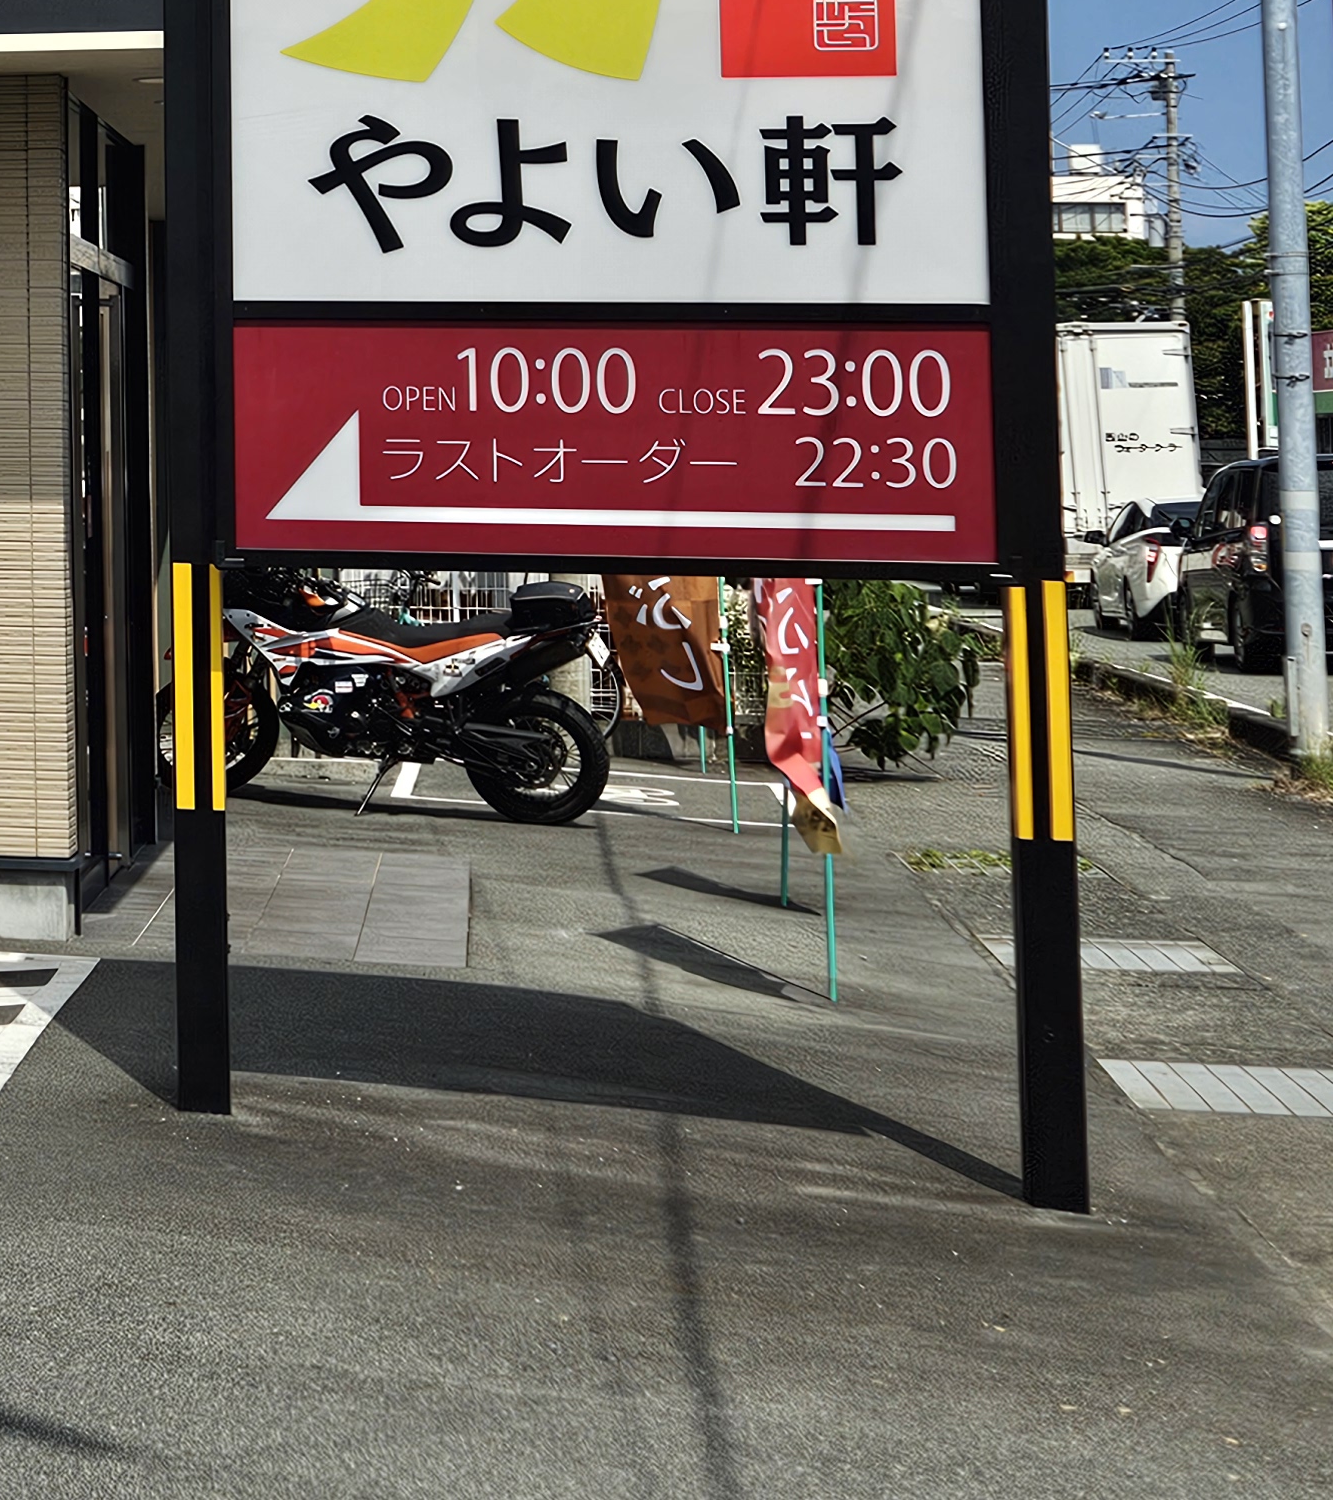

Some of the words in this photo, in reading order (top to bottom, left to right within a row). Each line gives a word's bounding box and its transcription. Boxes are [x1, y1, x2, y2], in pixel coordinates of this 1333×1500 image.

[308, 115, 902, 253] やよい軒
[382, 385, 456, 412] OPEN
[457, 347, 636, 413] 10:00
[658, 388, 746, 415] CLOSE
[757, 348, 951, 417] 23:00
[382, 437, 737, 483] ラストオーダー
[794, 436, 957, 488] 22:30
